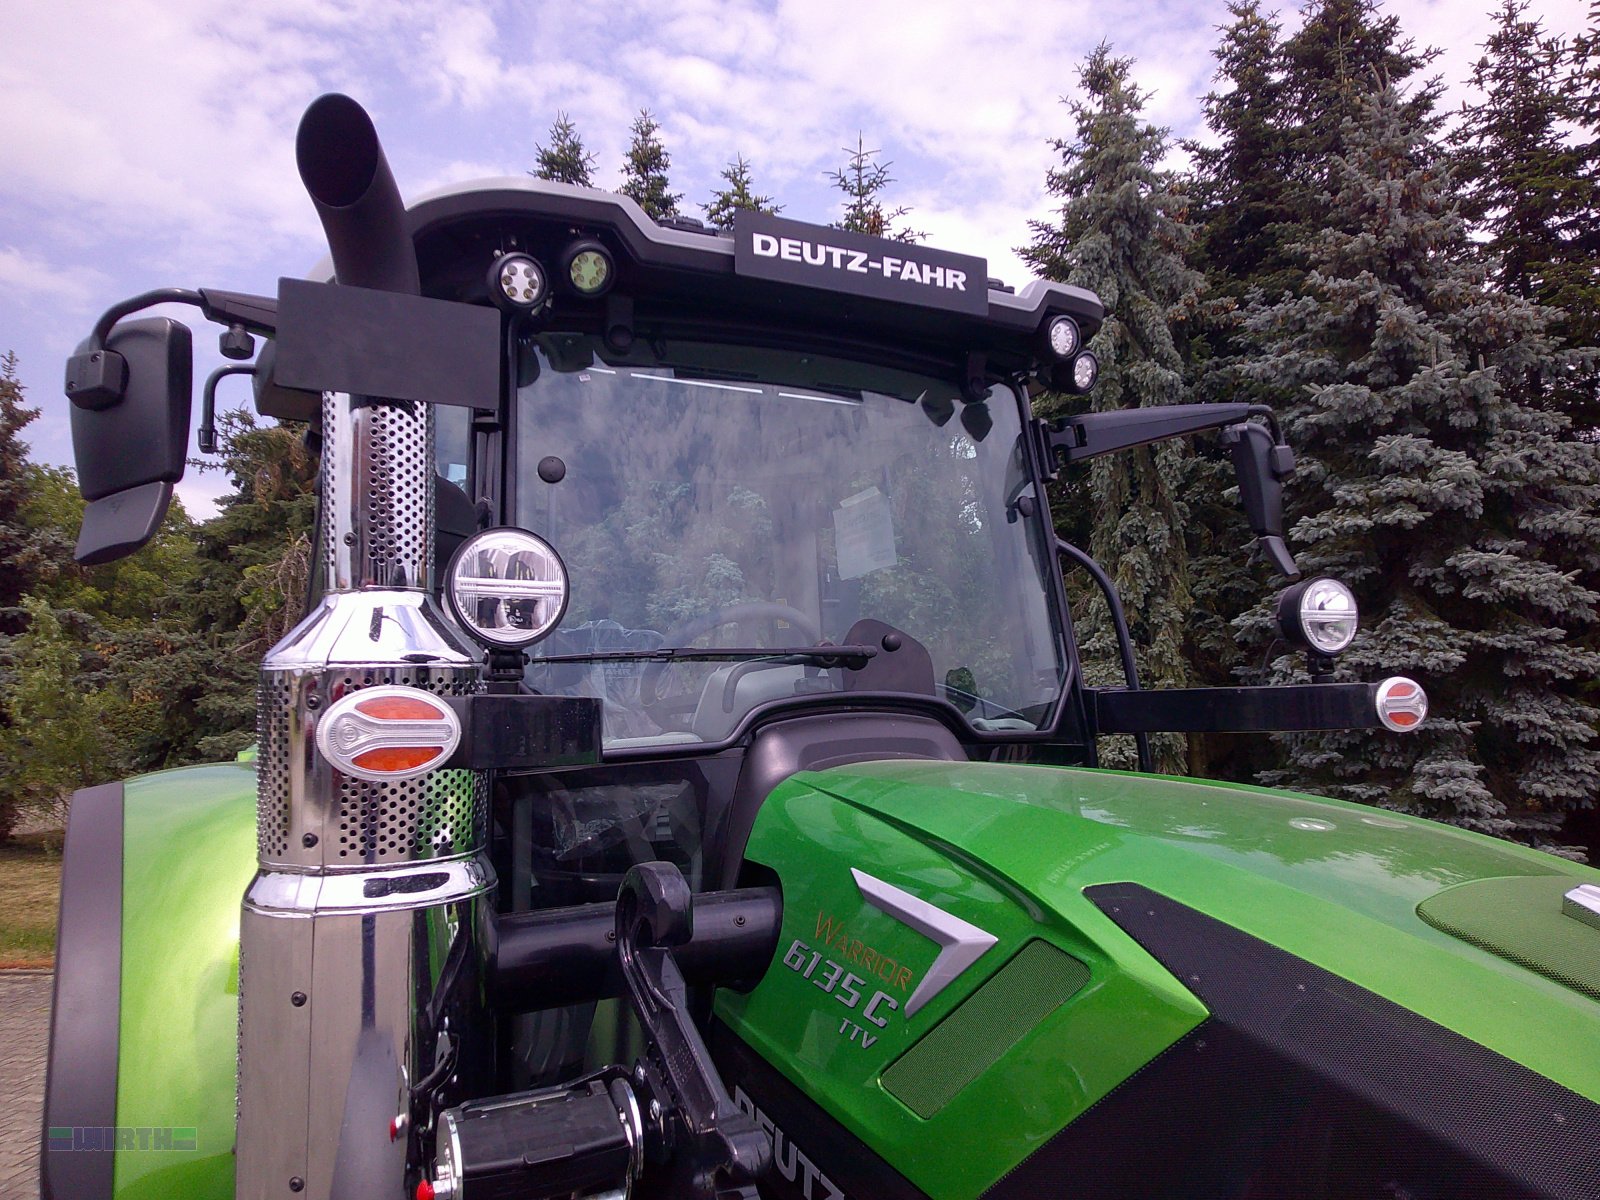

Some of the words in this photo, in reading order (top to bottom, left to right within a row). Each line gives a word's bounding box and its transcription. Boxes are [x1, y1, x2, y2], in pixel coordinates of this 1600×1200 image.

[752, 233, 967, 291] DEUTZ-FAHR
[783, 939, 866, 1008] 6135
[863, 990, 899, 1028] C
[815, 911, 913, 992] WARRIOR
[839, 1017, 878, 1049] TTV
